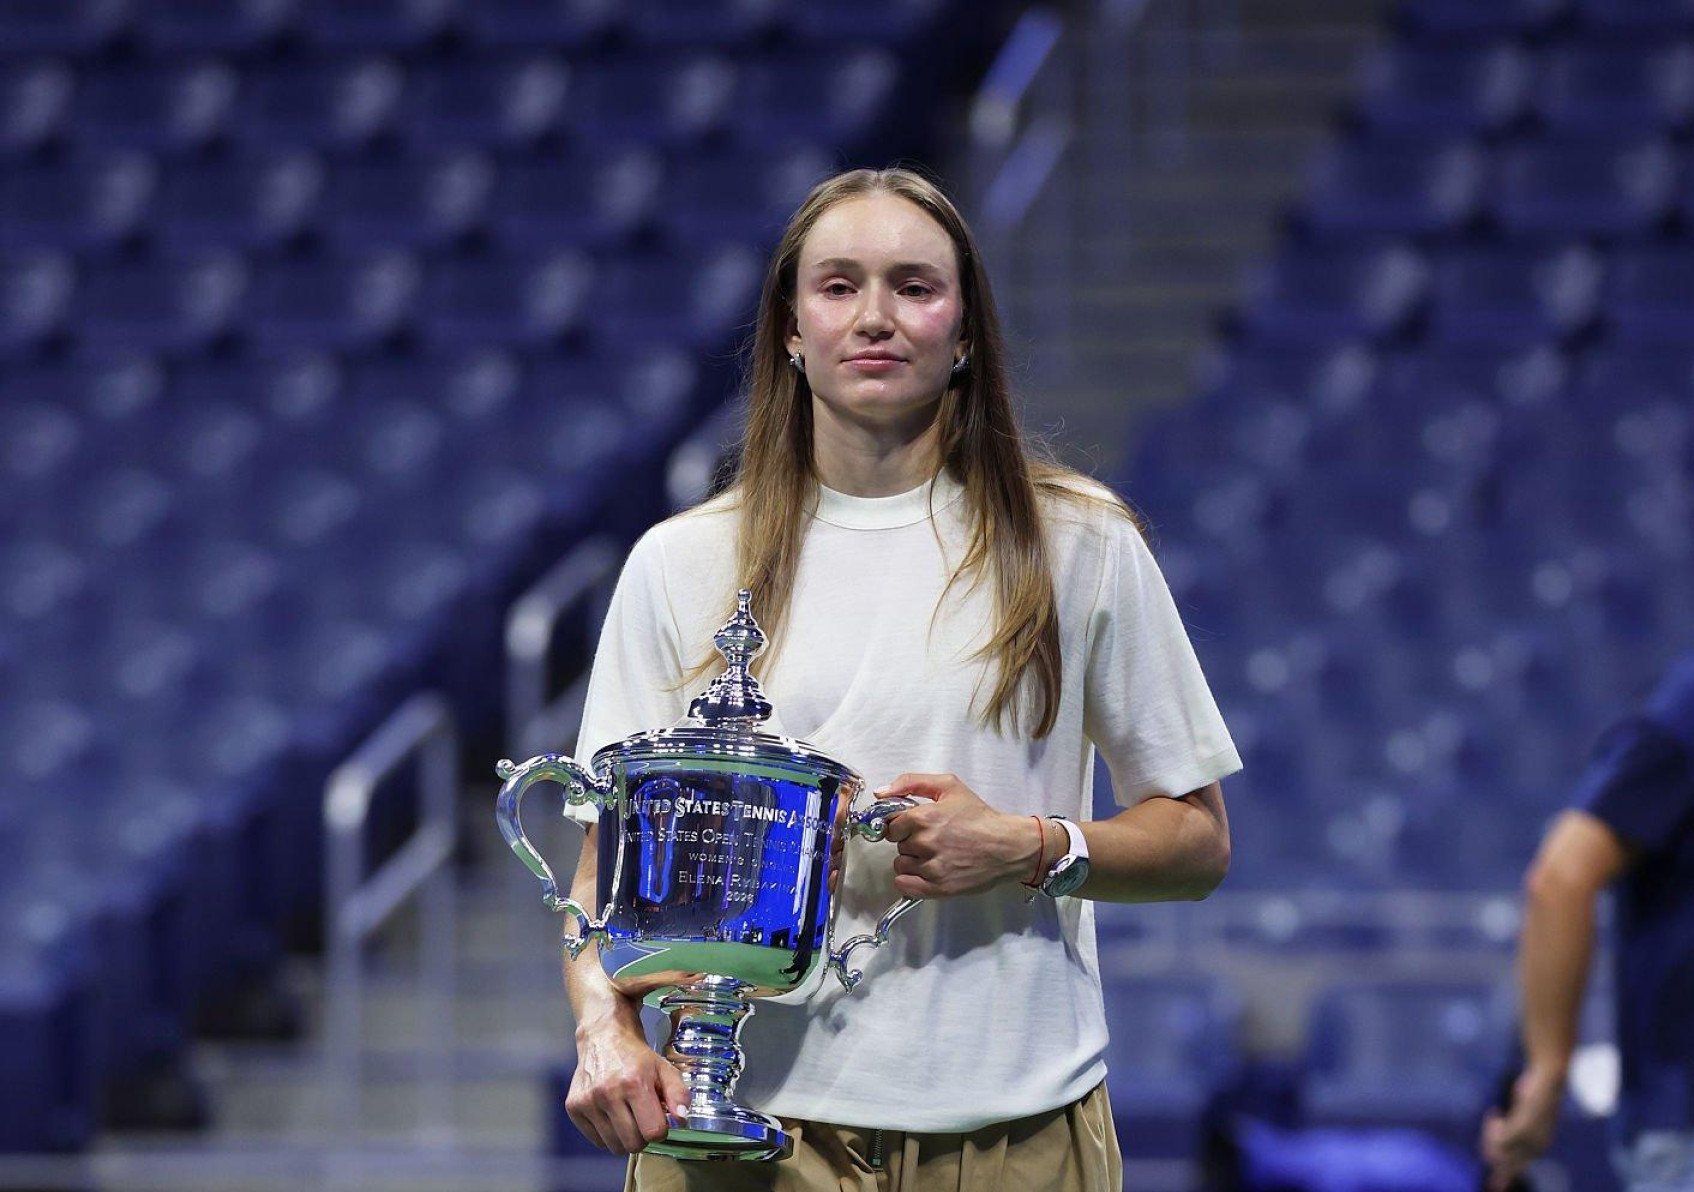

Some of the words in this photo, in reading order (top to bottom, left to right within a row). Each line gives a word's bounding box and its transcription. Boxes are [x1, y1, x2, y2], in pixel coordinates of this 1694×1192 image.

[675, 796, 731, 818] STATES
[732, 799, 788, 824] TENNIS
[658, 827, 699, 843] STATES
[678, 870, 724, 886] ELENA
